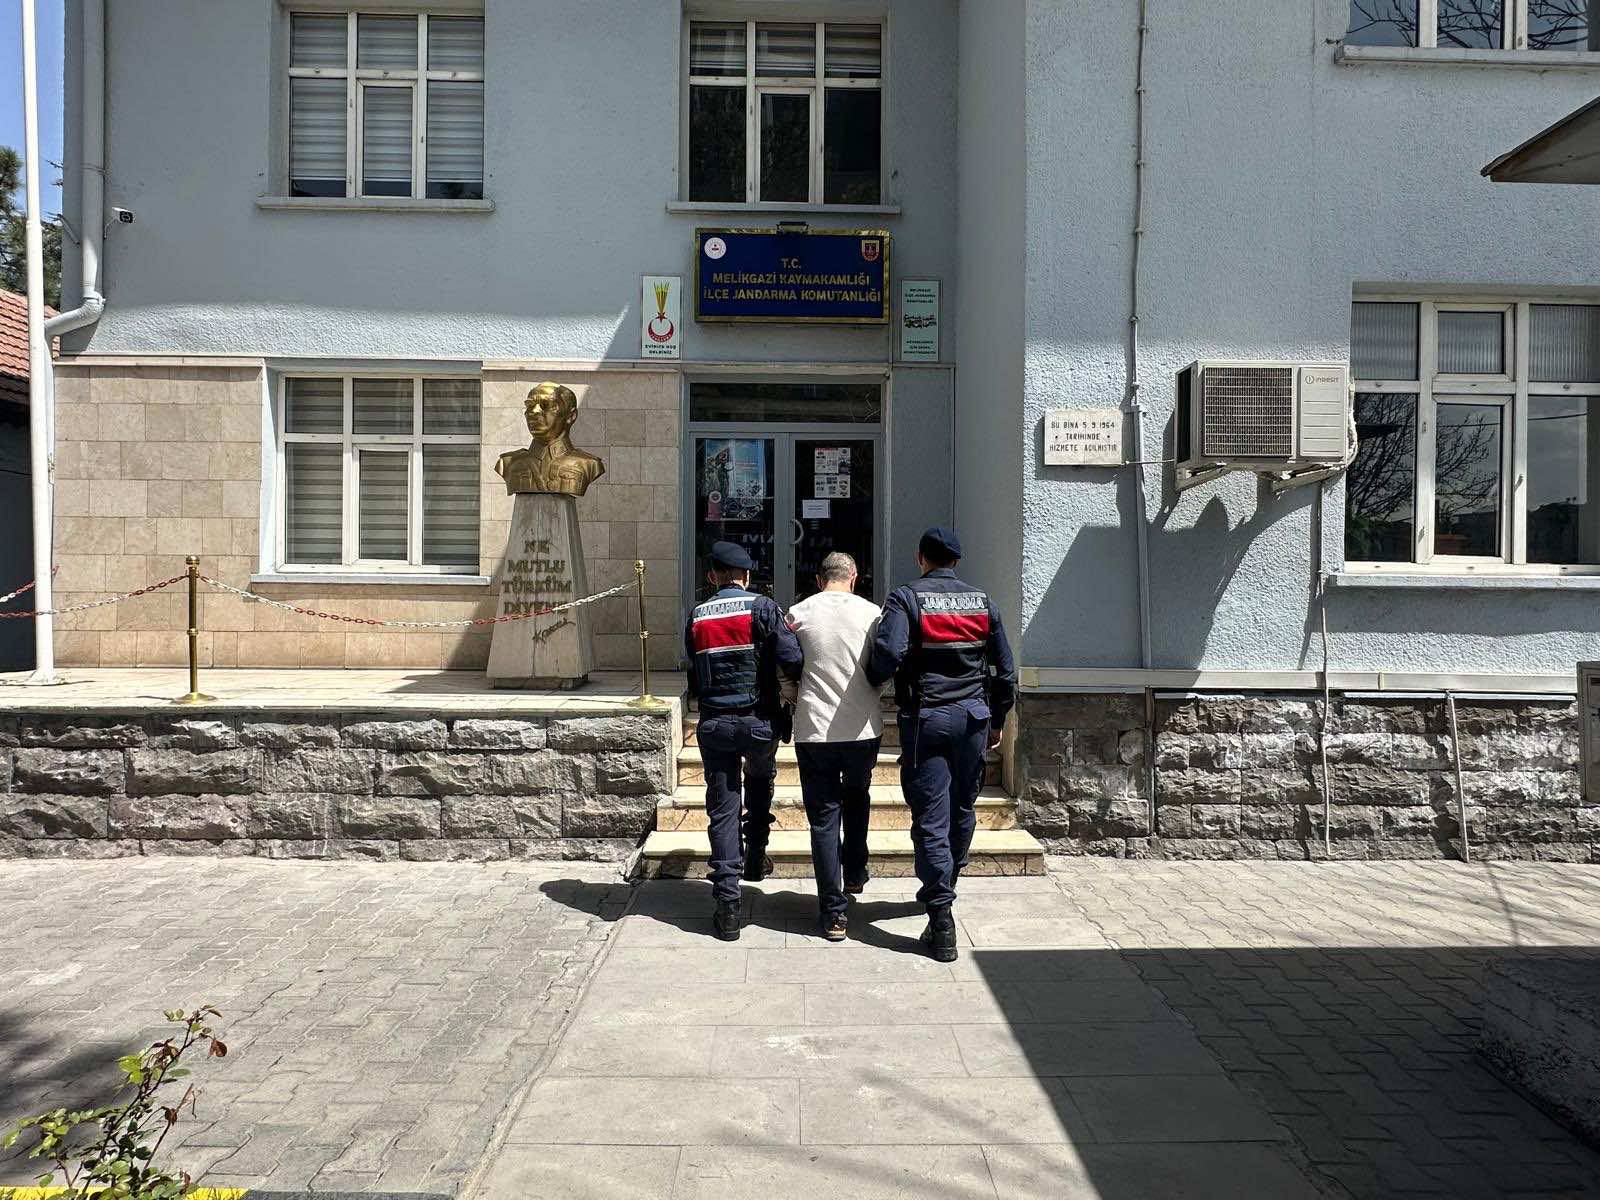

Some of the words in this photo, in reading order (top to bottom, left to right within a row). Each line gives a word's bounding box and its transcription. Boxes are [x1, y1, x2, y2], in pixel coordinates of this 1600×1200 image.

[781, 258, 802, 269] T.C.
[712, 270, 777, 284] MELİKGAZİ
[779, 272, 870, 286] KAYMAKAMLIĞI
[703, 285, 729, 302] İLÇE
[732, 289, 798, 300] JANDARMA
[800, 288, 881, 303] KOMUTANLIĞI
[1050, 421, 1060, 429] BU
[524, 540, 550, 554] NE
[507, 560, 565, 573] MUTLU
[502, 575, 572, 594] TÜRKÜM
[697, 600, 746, 617] JANDARMA
[922, 597, 985, 609] JANDARMA
